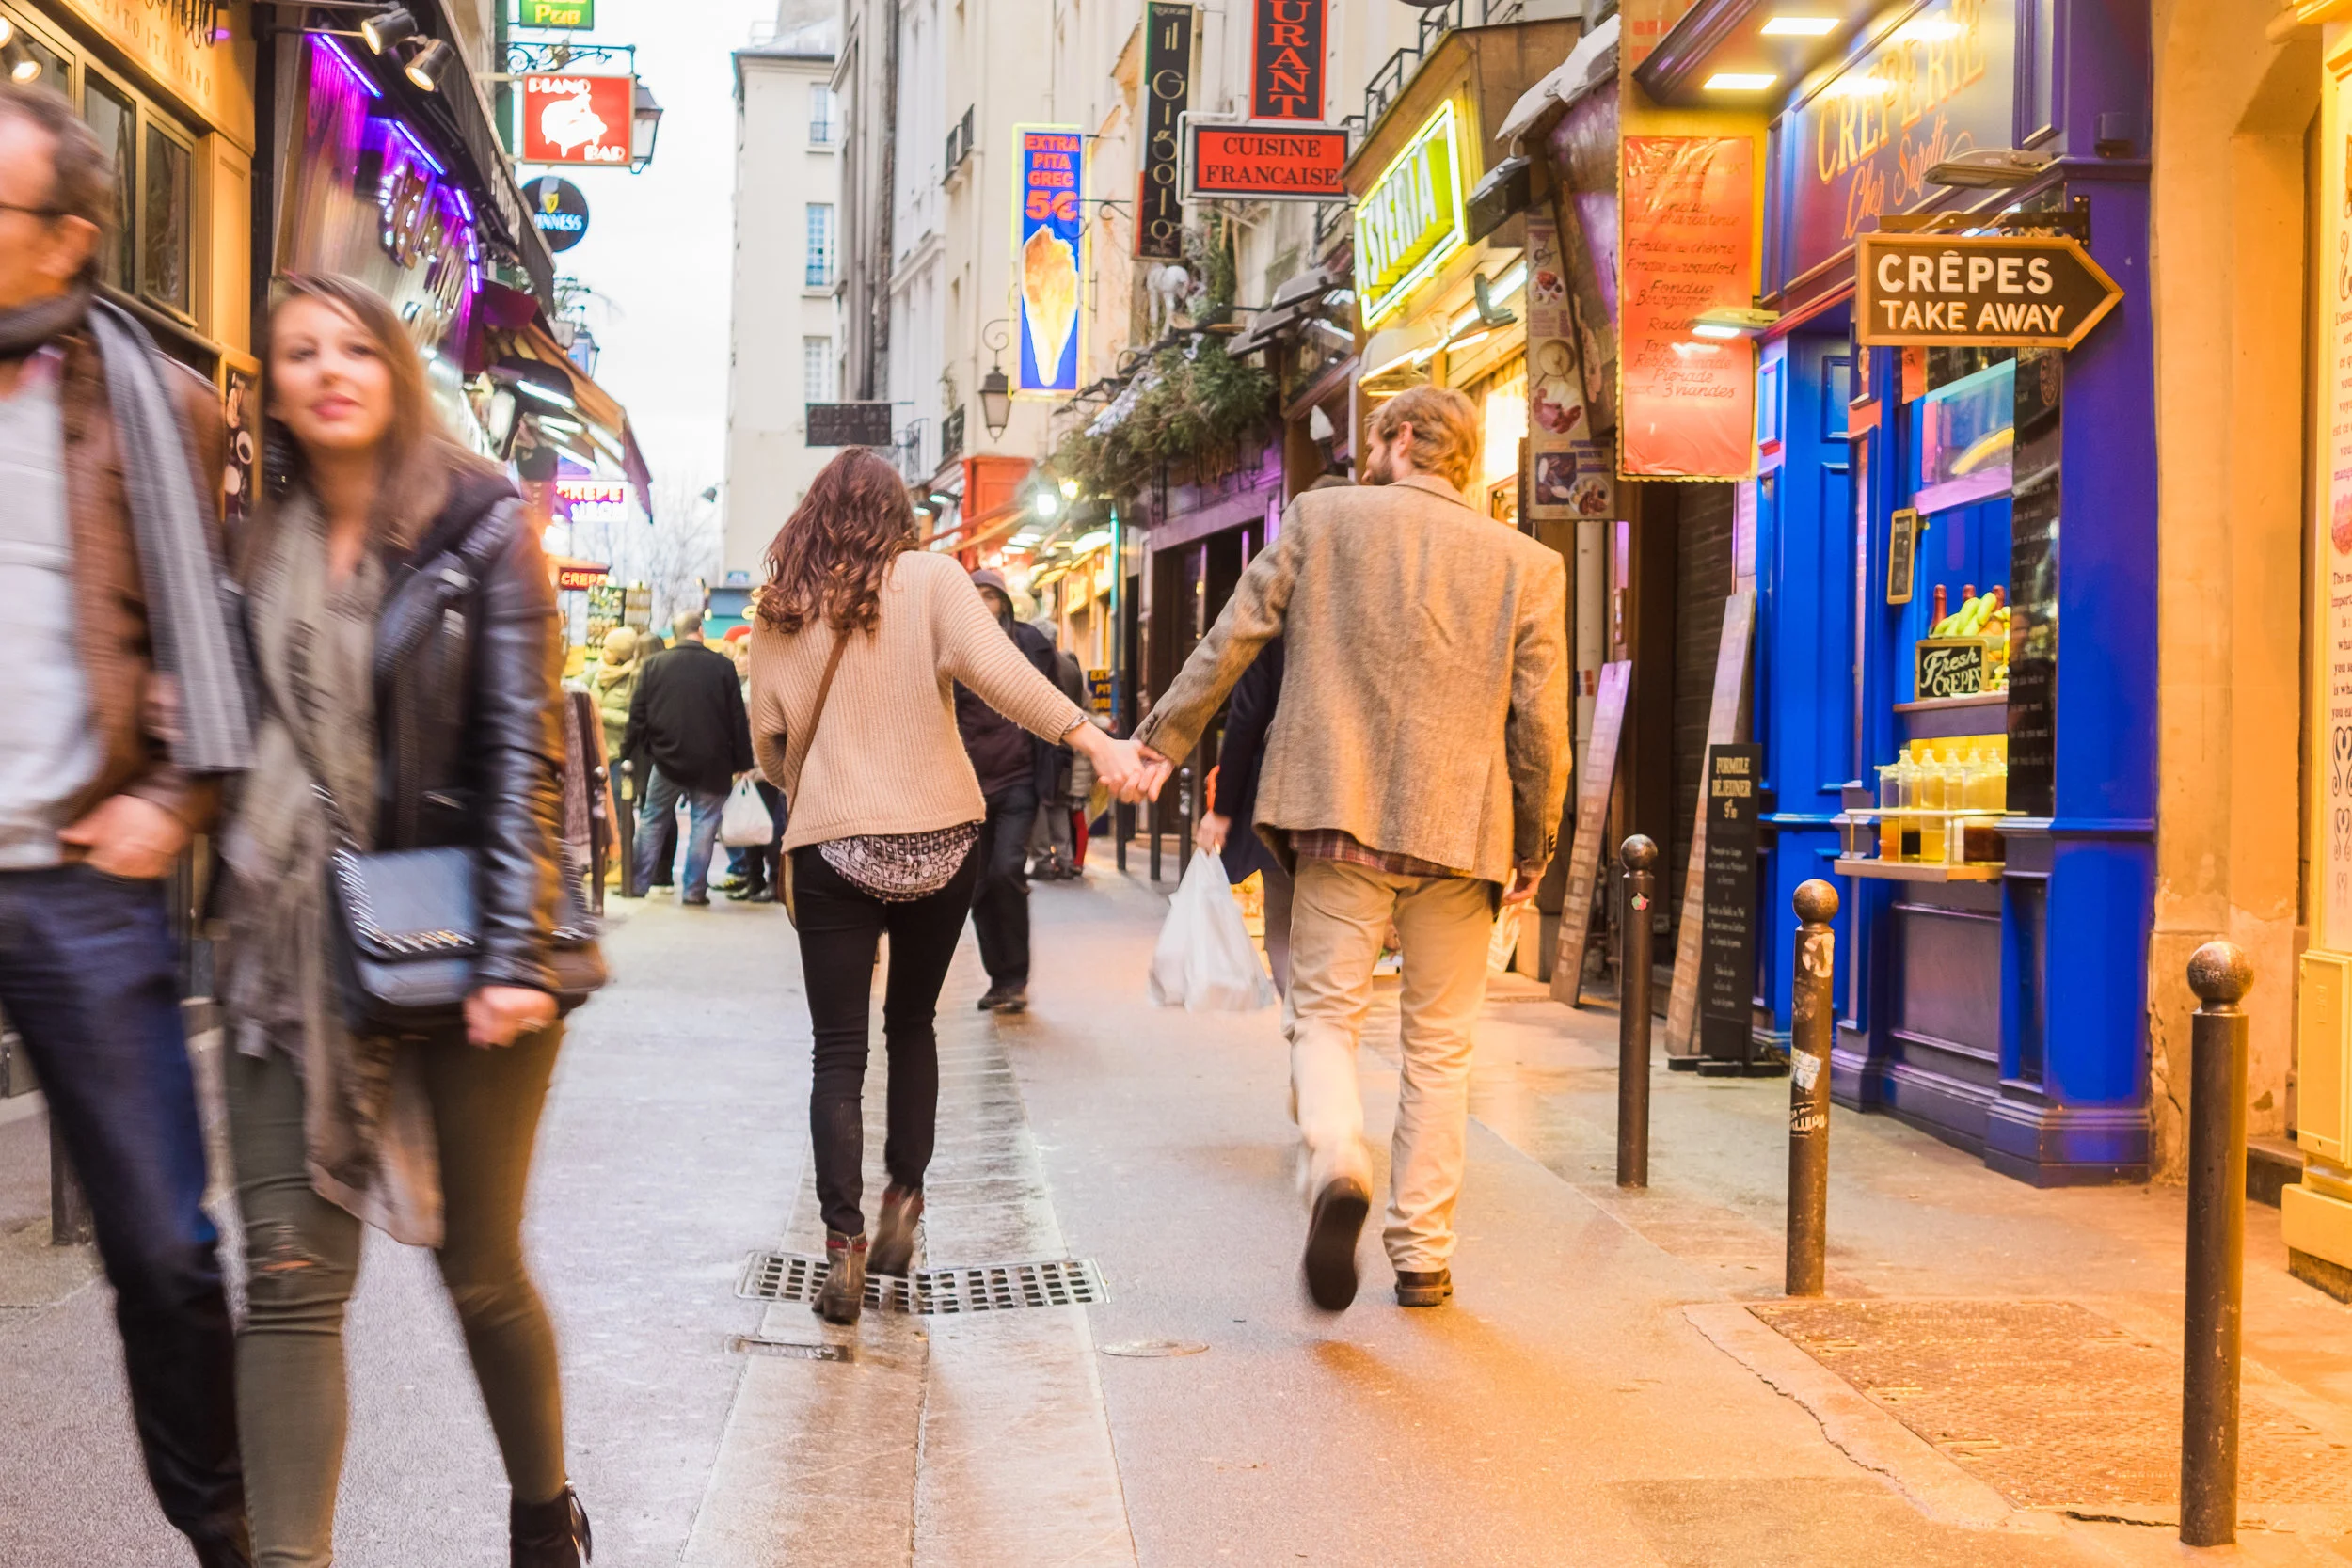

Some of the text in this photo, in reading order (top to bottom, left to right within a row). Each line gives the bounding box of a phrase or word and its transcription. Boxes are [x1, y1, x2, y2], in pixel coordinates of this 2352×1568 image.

[146, 27, 211, 97] ITALIANO
[528, 77, 592, 95] PIANO
[584, 144, 626, 161] BAR
[1025, 135, 1080, 152] EXTRA
[1223, 137, 1321, 158] CUISINE
[1032, 152, 1072, 169] PITA
[1028, 170, 1074, 187] GREC
[1204, 165, 1339, 186] FRANCAISE
[1025, 190, 1077, 221] 5€
[1877, 250, 2054, 294] CRÊPES
[1650, 280, 1714, 294] Fondue
[1879, 300, 2065, 333] TAKE AWAY
[1662, 382, 1673, 397] 3
[1676, 385, 1736, 397] viandes
[1920, 646, 1979, 688] Fresh
[1932, 666, 1981, 696] CREPES
